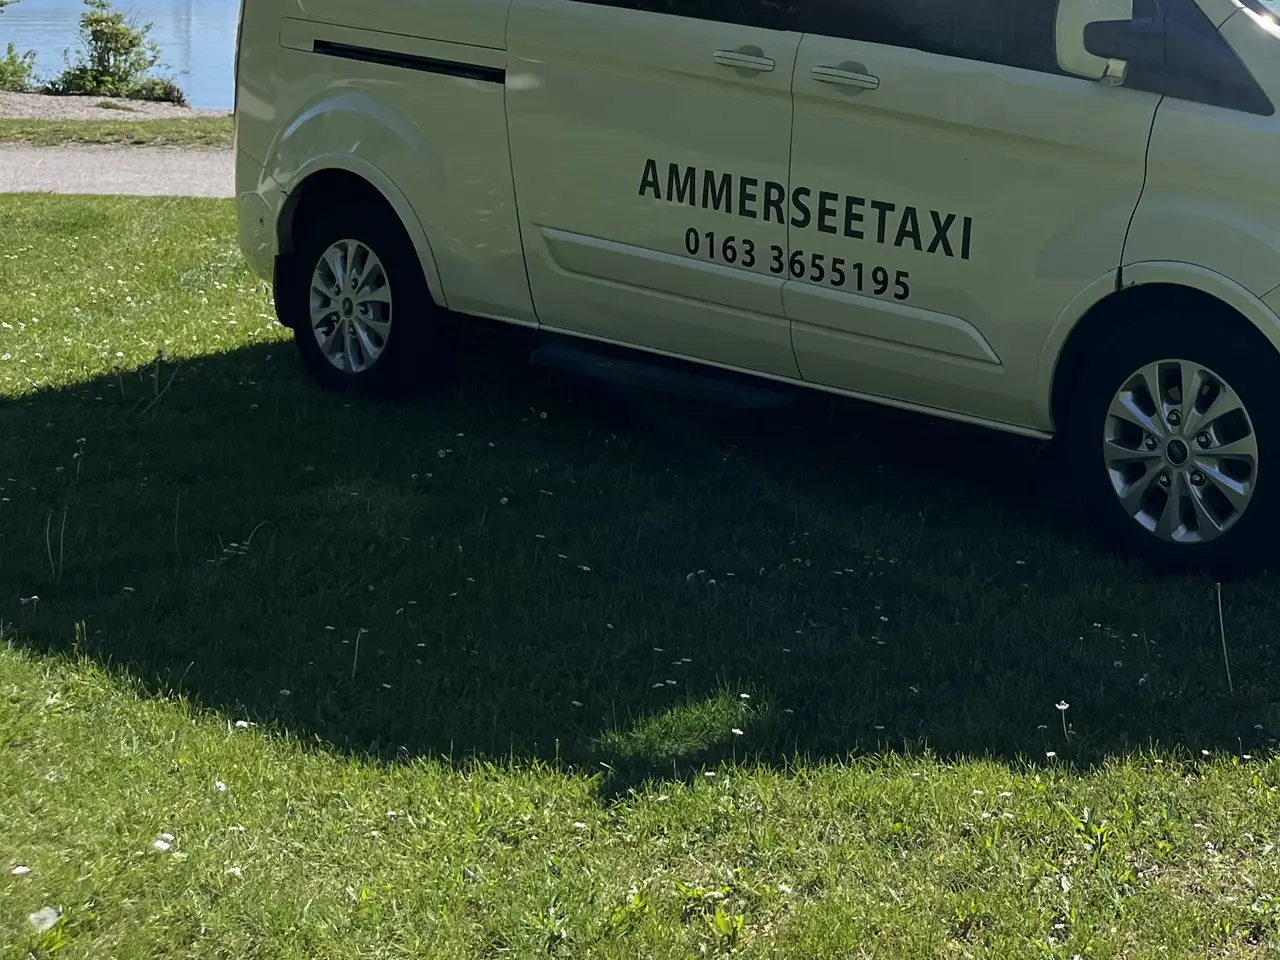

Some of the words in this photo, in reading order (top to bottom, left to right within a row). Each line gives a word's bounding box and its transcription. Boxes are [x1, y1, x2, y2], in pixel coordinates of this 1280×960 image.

[638, 158, 973, 260] AMMERSEETAXI
[684, 227, 756, 267] 0163
[769, 244, 911, 301] 3655195
